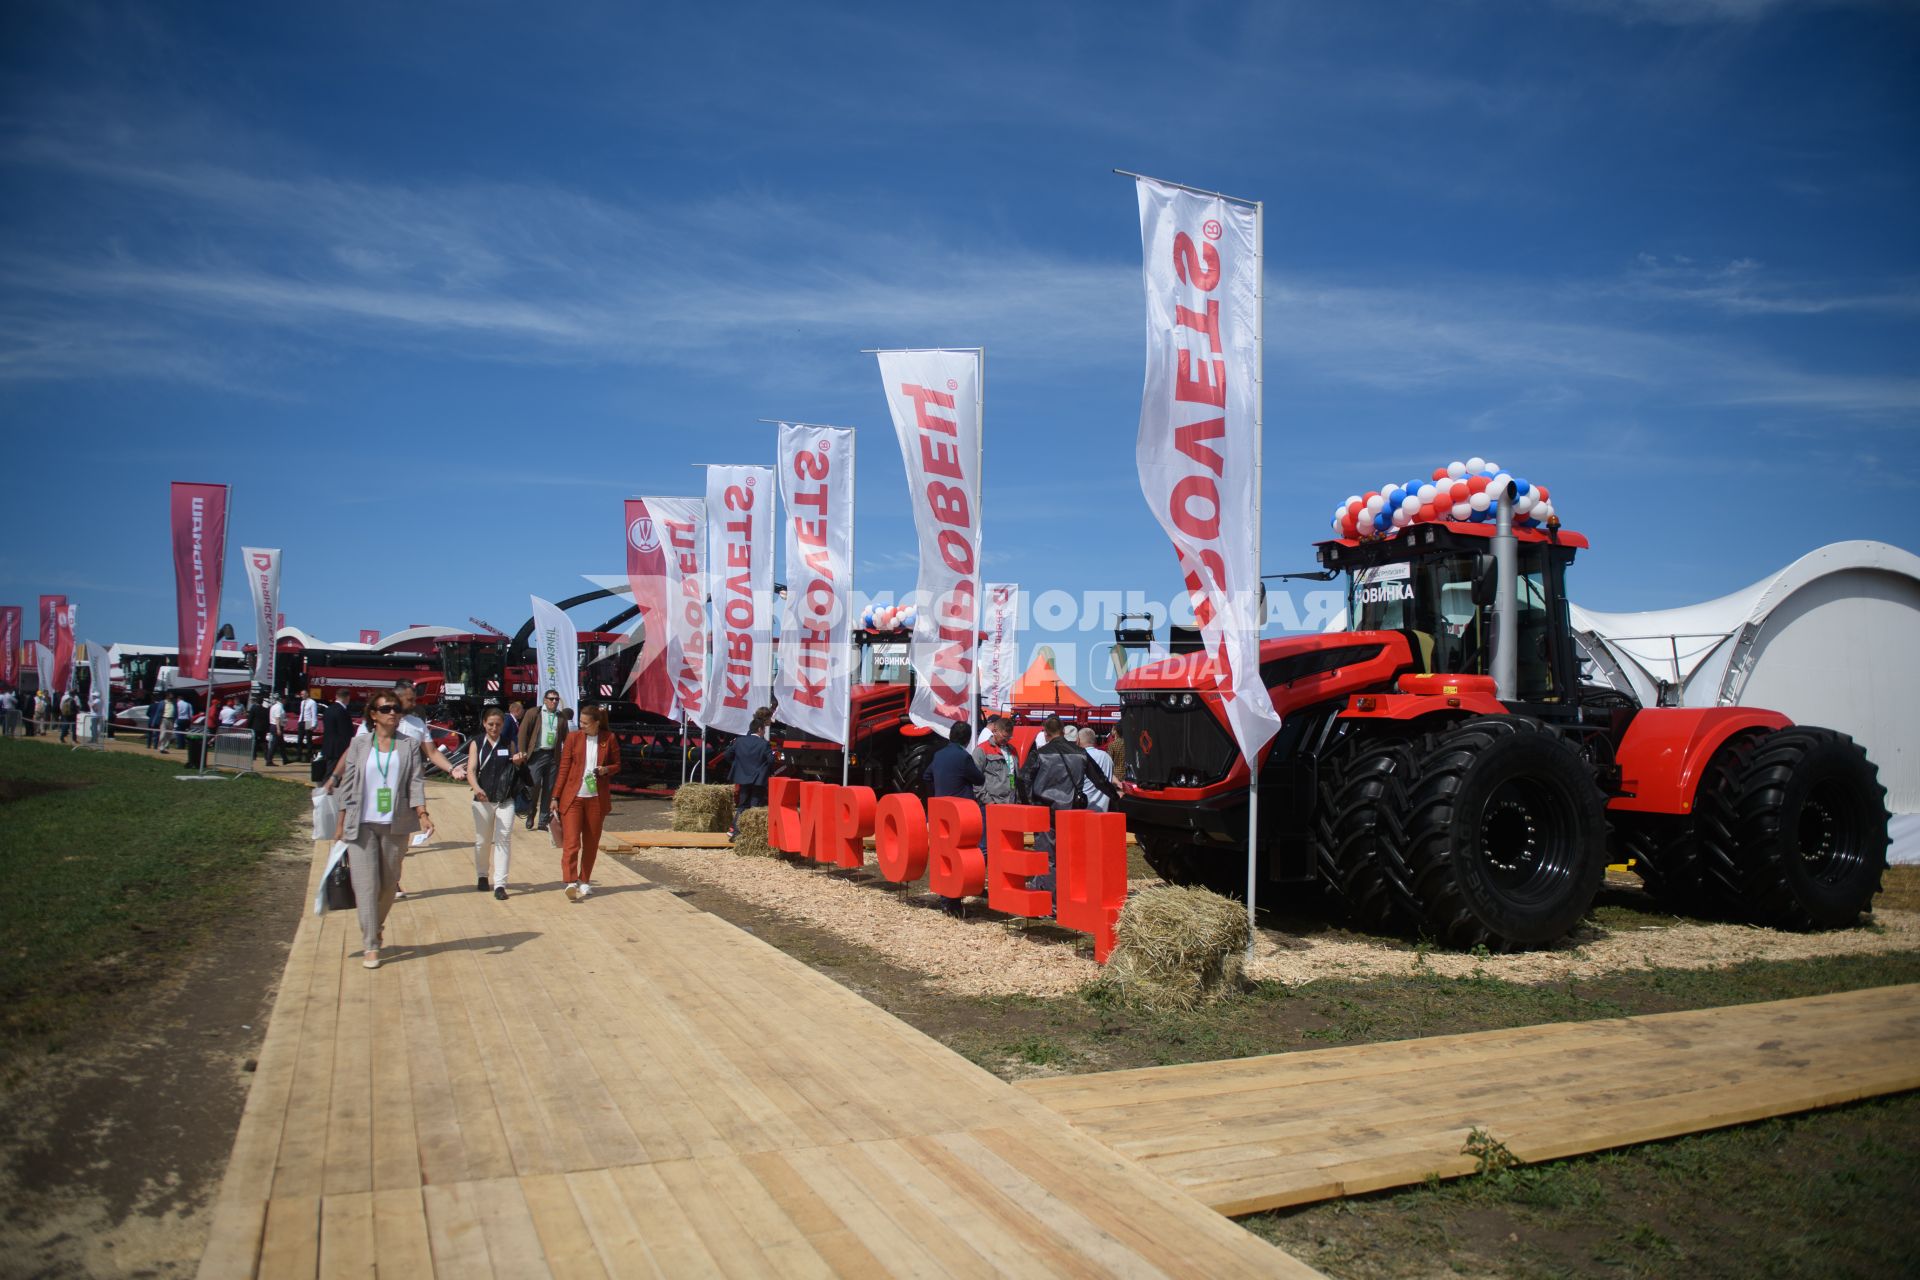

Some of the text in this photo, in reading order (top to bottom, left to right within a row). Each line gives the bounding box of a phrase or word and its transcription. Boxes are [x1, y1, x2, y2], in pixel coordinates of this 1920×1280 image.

[1355, 583, 1415, 604] НОВИНКА
[874, 656, 911, 667] НОВИНКА
[768, 776, 1128, 965] КИРОВЕЦ
